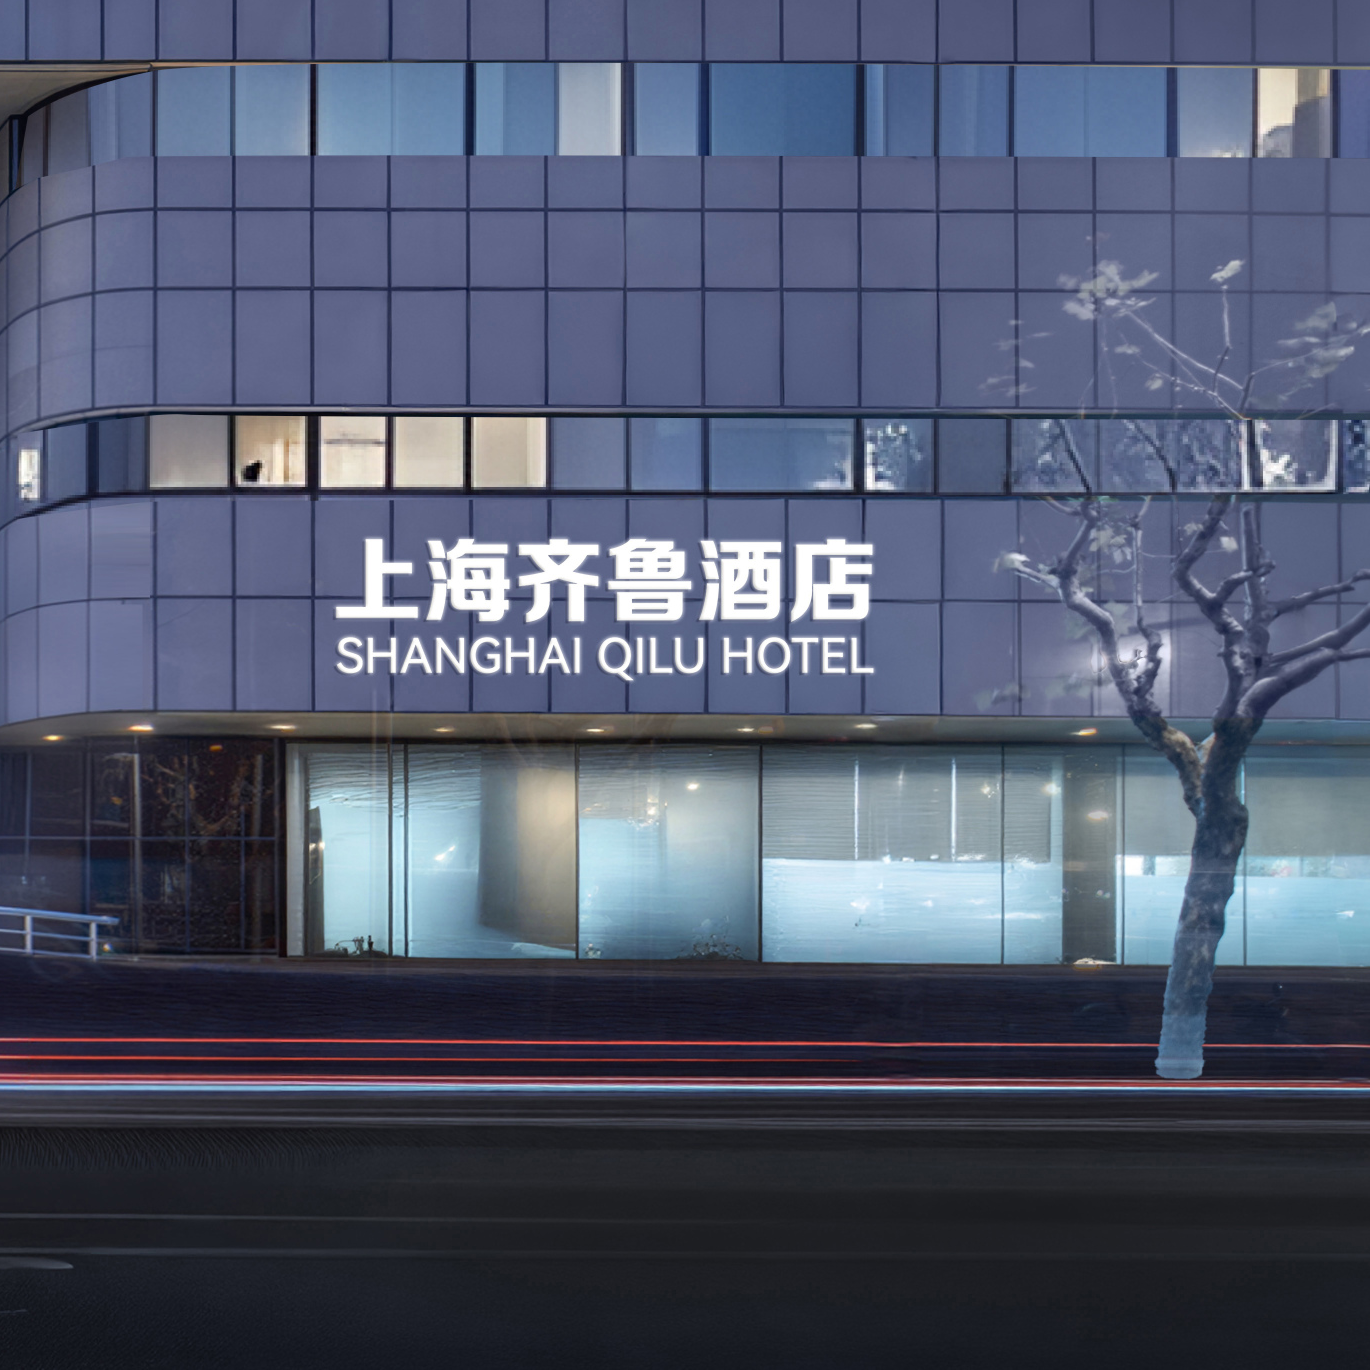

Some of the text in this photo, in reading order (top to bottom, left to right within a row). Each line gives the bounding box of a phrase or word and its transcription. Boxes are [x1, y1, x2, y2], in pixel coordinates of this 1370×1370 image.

[335, 538, 874, 623] 上海齐鲁酒店
[336, 636, 875, 681] SHANGHAI QILU HOTEL
